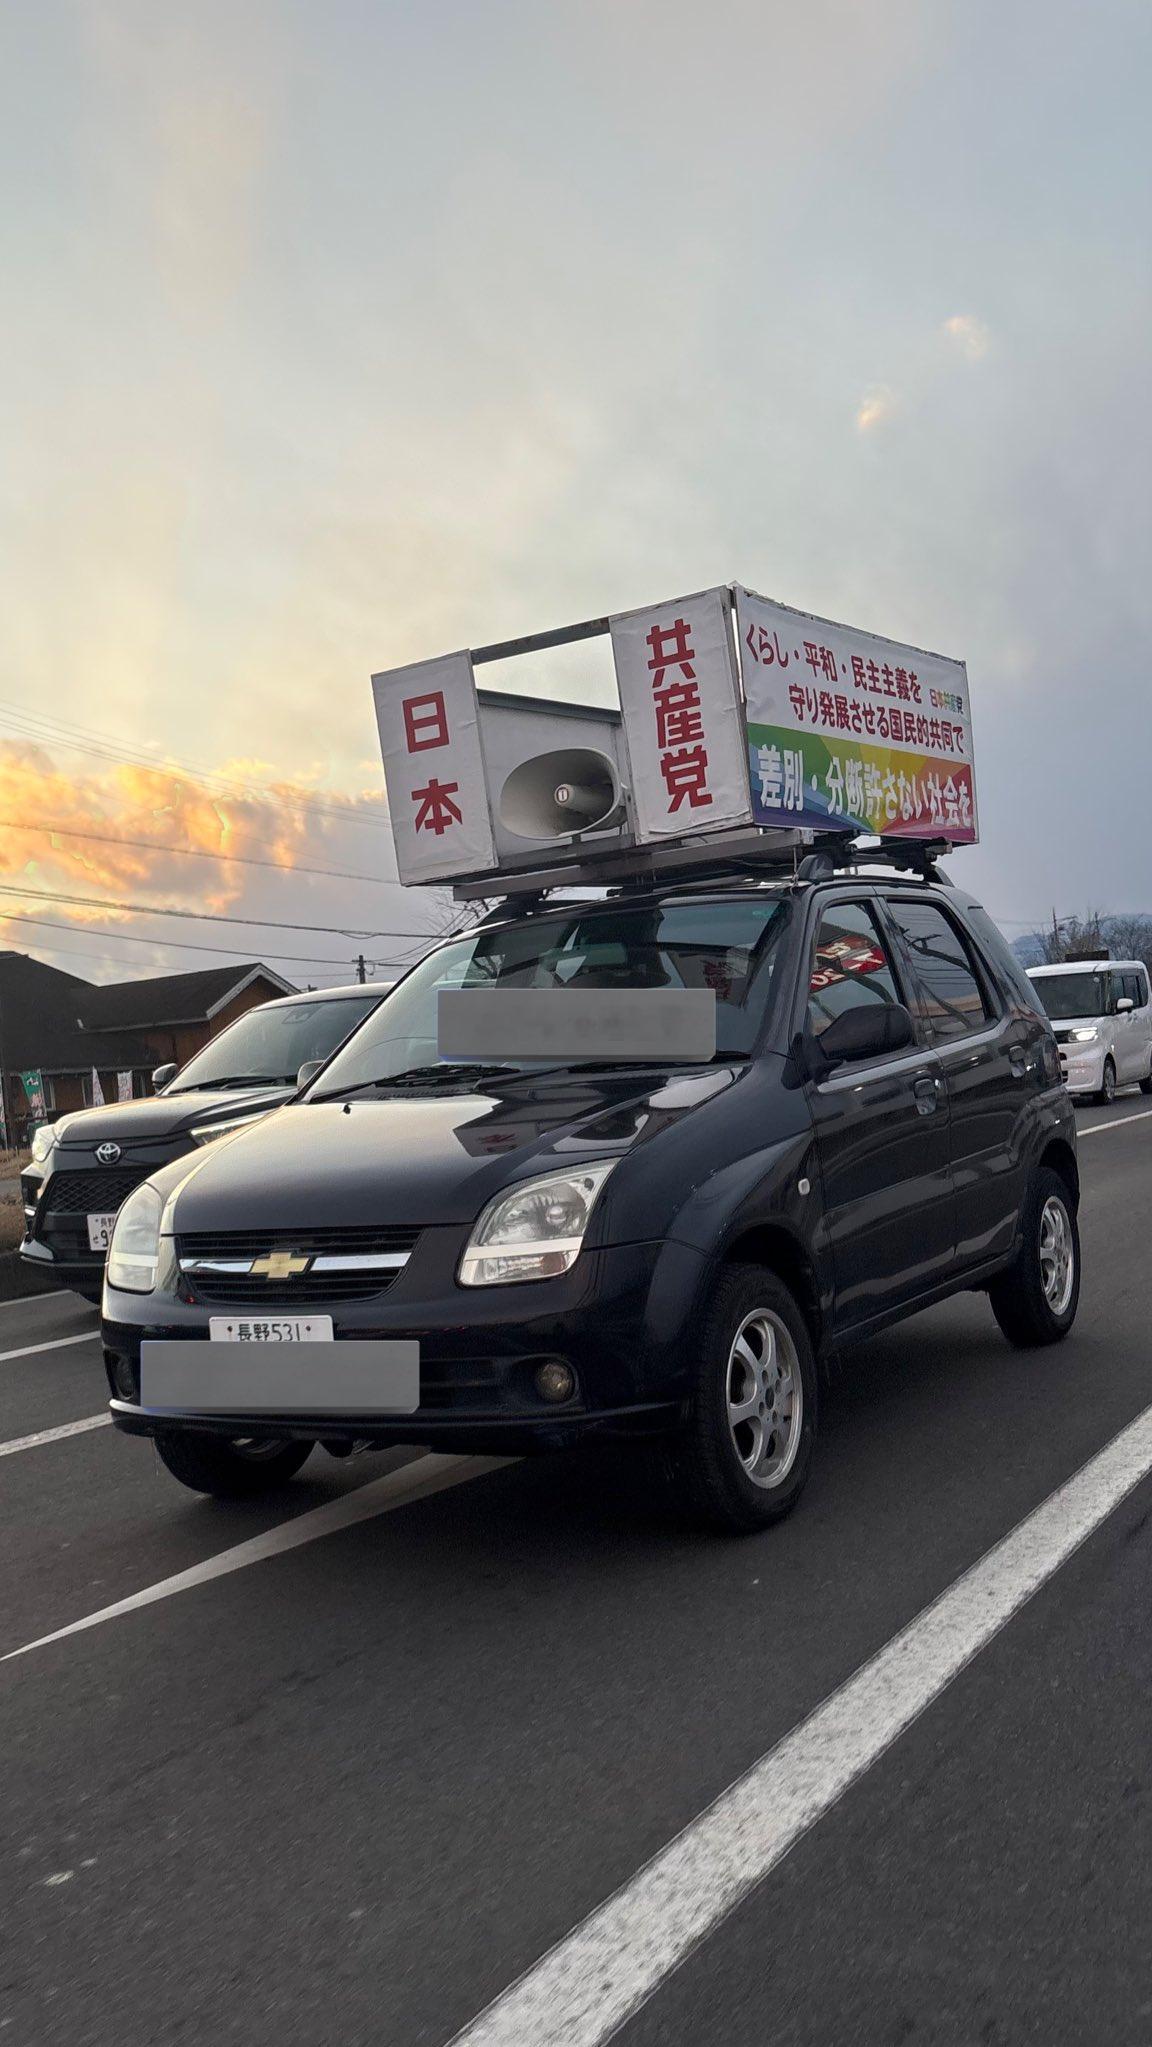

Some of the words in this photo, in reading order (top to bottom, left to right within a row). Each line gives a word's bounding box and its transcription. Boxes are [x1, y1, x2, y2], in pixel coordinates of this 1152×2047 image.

[746, 623, 922, 704] くらし・平和・民主主義を
[645, 618, 714, 814] 共産党
[788, 682, 964, 754] 守り発展させる国民的共同で
[402, 690, 464, 836] 日本
[757, 743, 971, 828] 差別・分断許さない社会を
